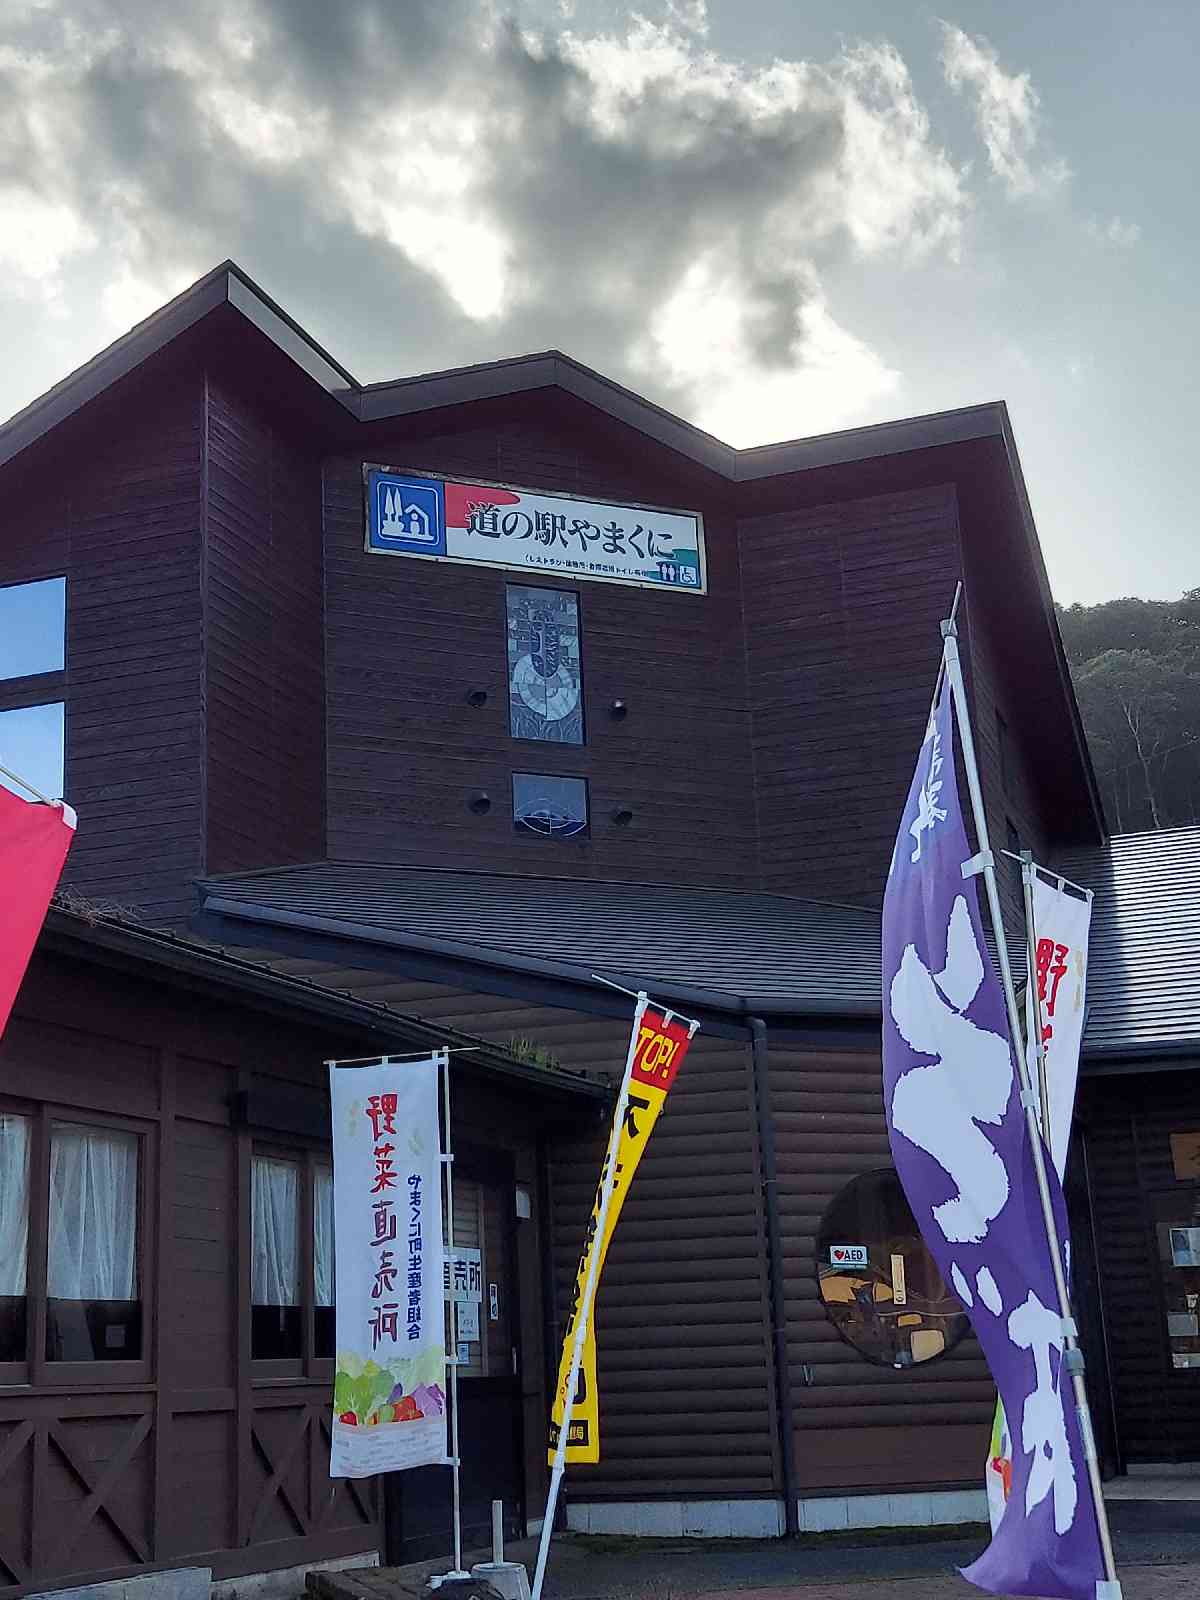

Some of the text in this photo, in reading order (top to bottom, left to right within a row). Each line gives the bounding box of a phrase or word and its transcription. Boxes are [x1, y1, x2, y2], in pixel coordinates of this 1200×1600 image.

[467, 502, 673, 560] 道の駅やまくに
[843, 1249, 864, 1260] AED
